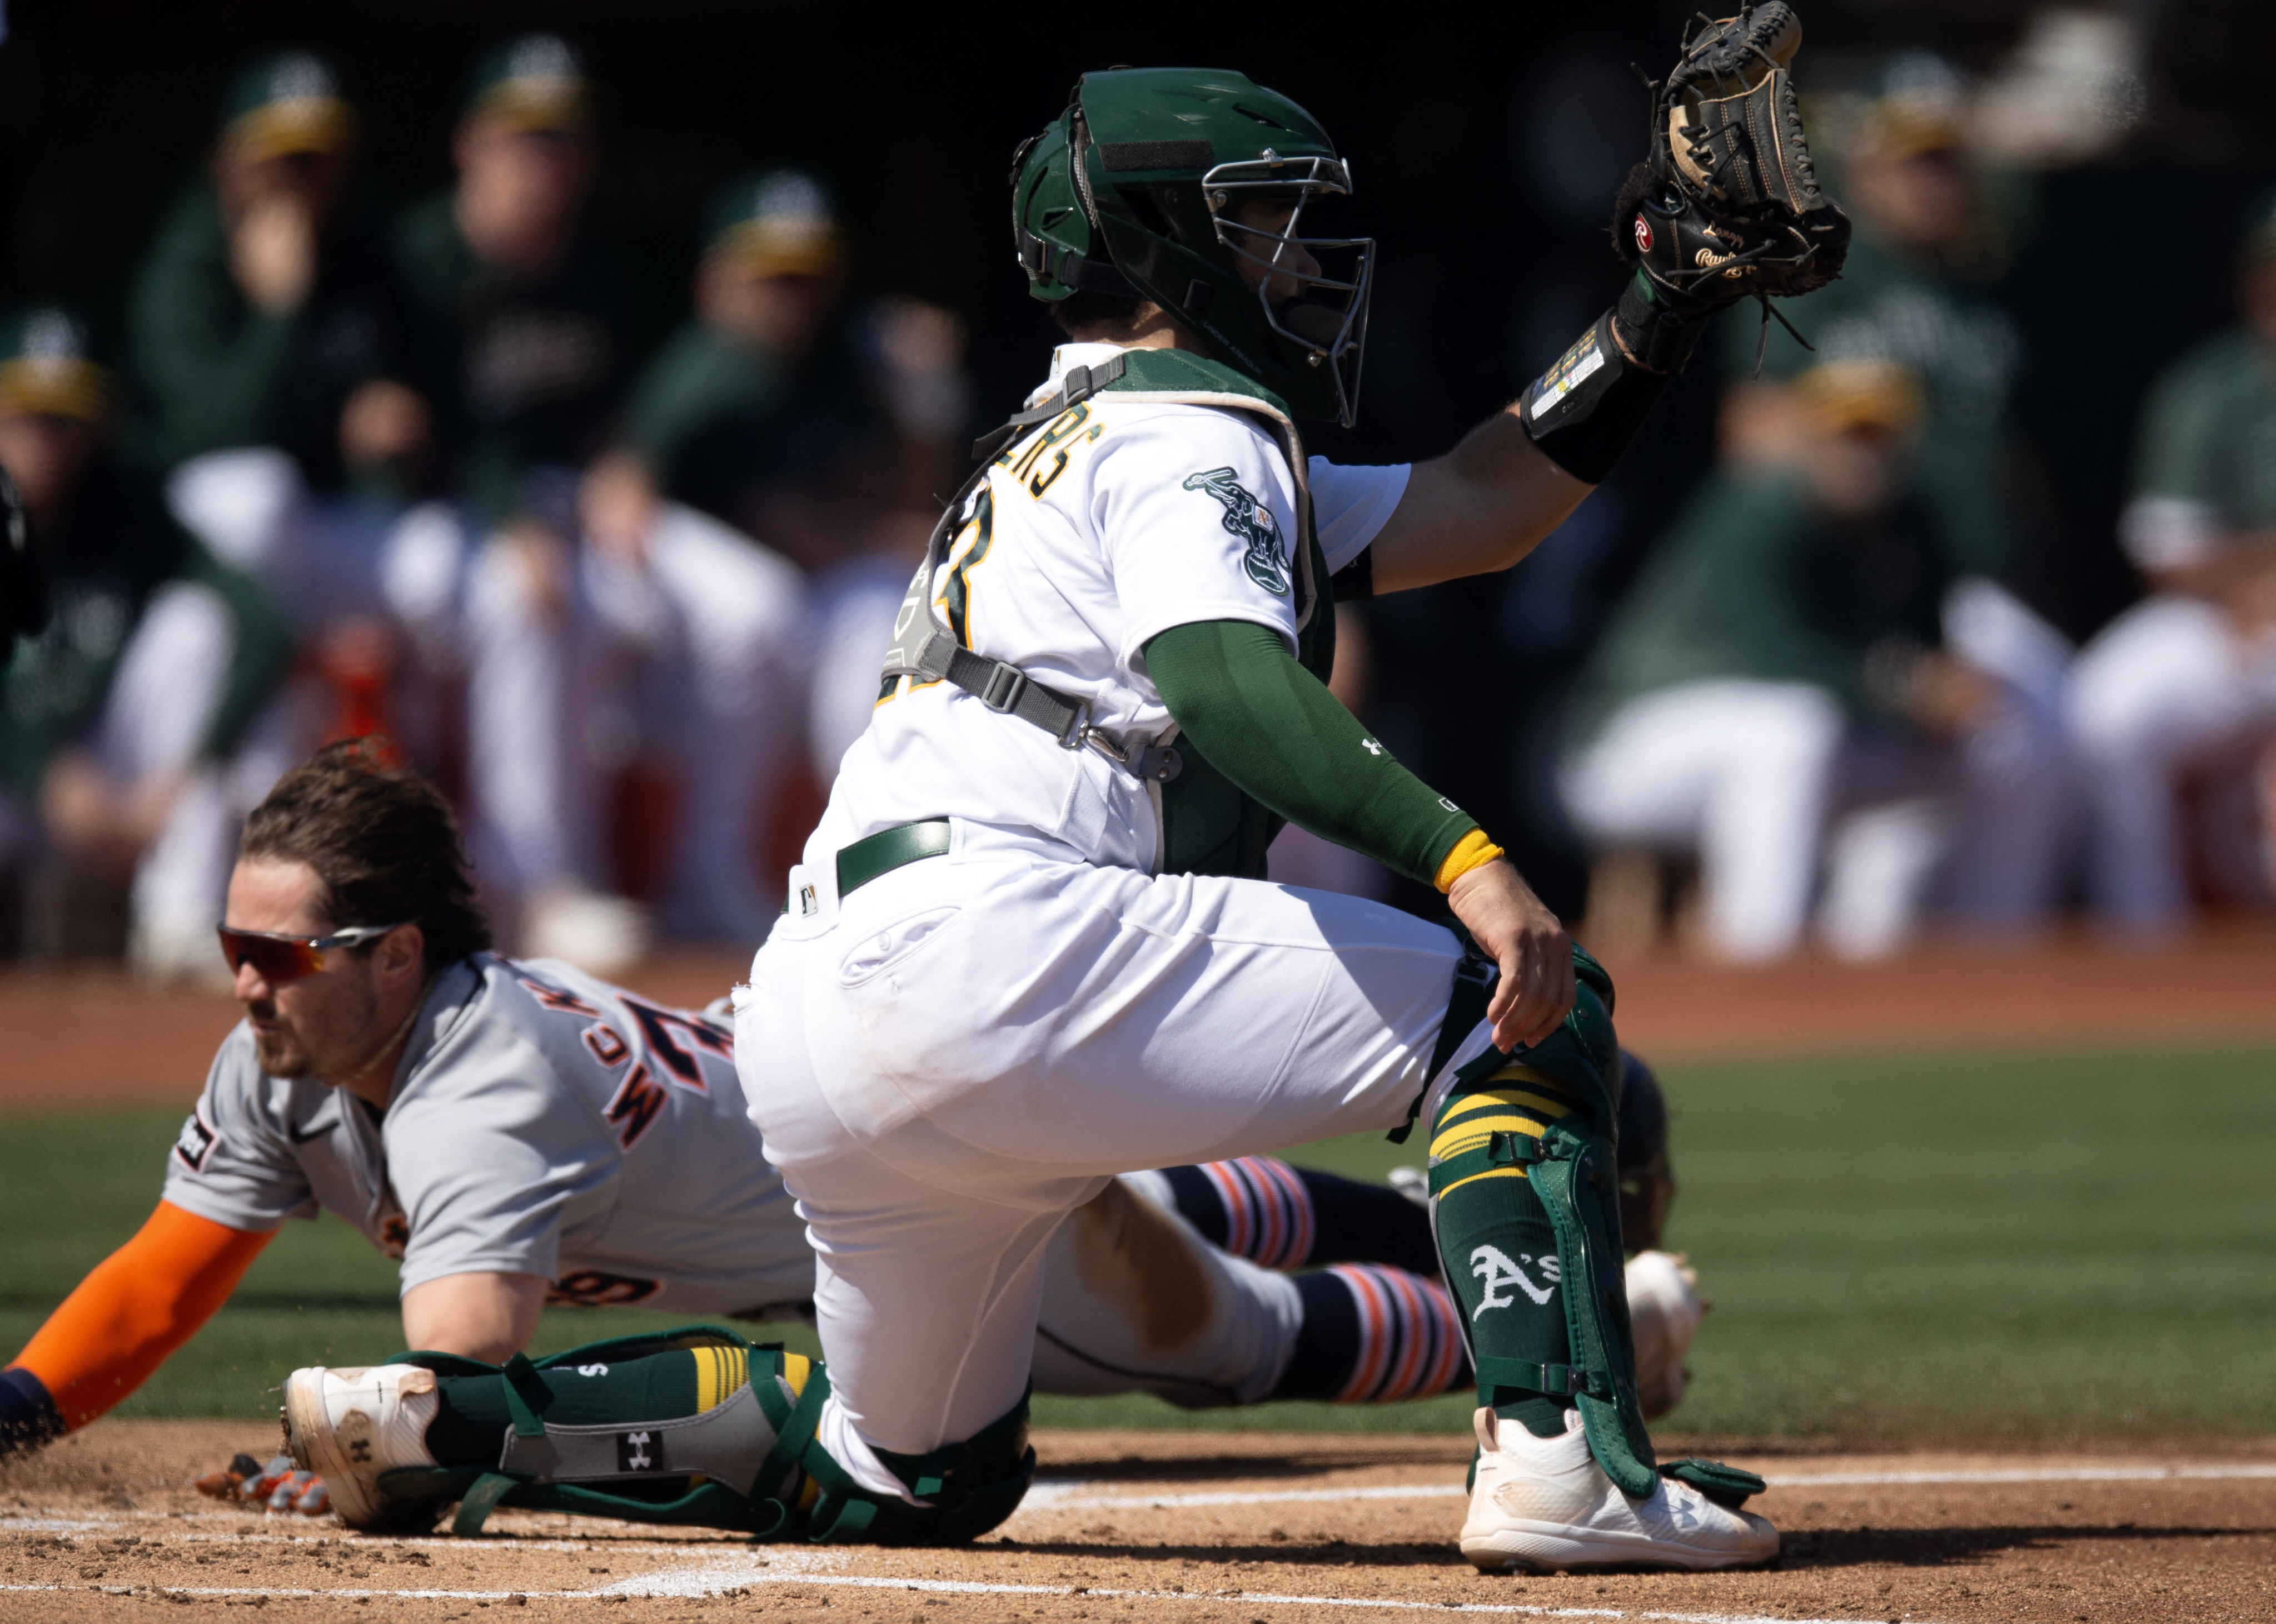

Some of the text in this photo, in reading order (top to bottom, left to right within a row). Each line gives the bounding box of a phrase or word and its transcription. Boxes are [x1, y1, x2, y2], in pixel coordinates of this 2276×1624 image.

[1703, 220, 1745, 249] Langy
[1203, 321, 1262, 376] UNDER ARMOUR
[1470, 1244, 1561, 1322] A's
